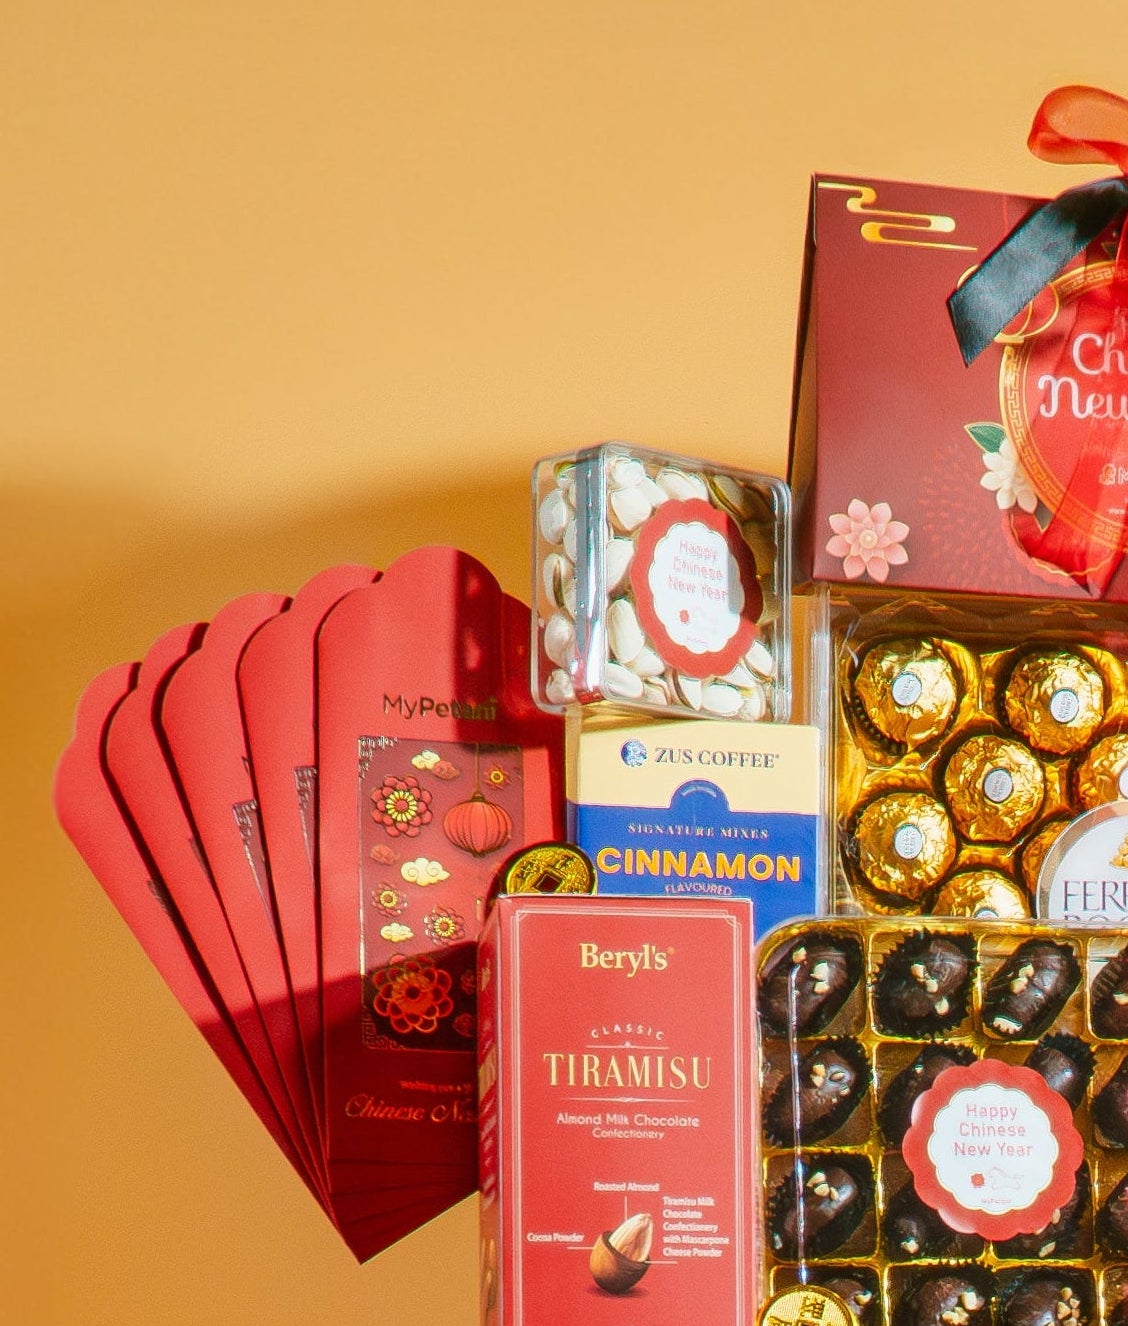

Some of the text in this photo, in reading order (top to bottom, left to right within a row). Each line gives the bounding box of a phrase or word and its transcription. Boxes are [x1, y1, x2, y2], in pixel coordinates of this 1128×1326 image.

[655, 747, 776, 768] ZUS COFFEE
[627, 822, 769, 839] SIGNATURE MIXES
[597, 847, 800, 882] CINNAMON
[664, 882, 733, 896] FLAVOURED
[579, 942, 669, 978] Beryl's
[591, 1023, 665, 1041] CLASSIC
[543, 1053, 712, 1089] TIRAMISU
[556, 1112, 700, 1128] Almond Milk Chocolate
[966, 1104, 1018, 1120] Happy
[592, 1127, 665, 1140] Confectionery
[959, 1123, 1026, 1137] Chinese
[954, 1142, 1034, 1157] New Year
